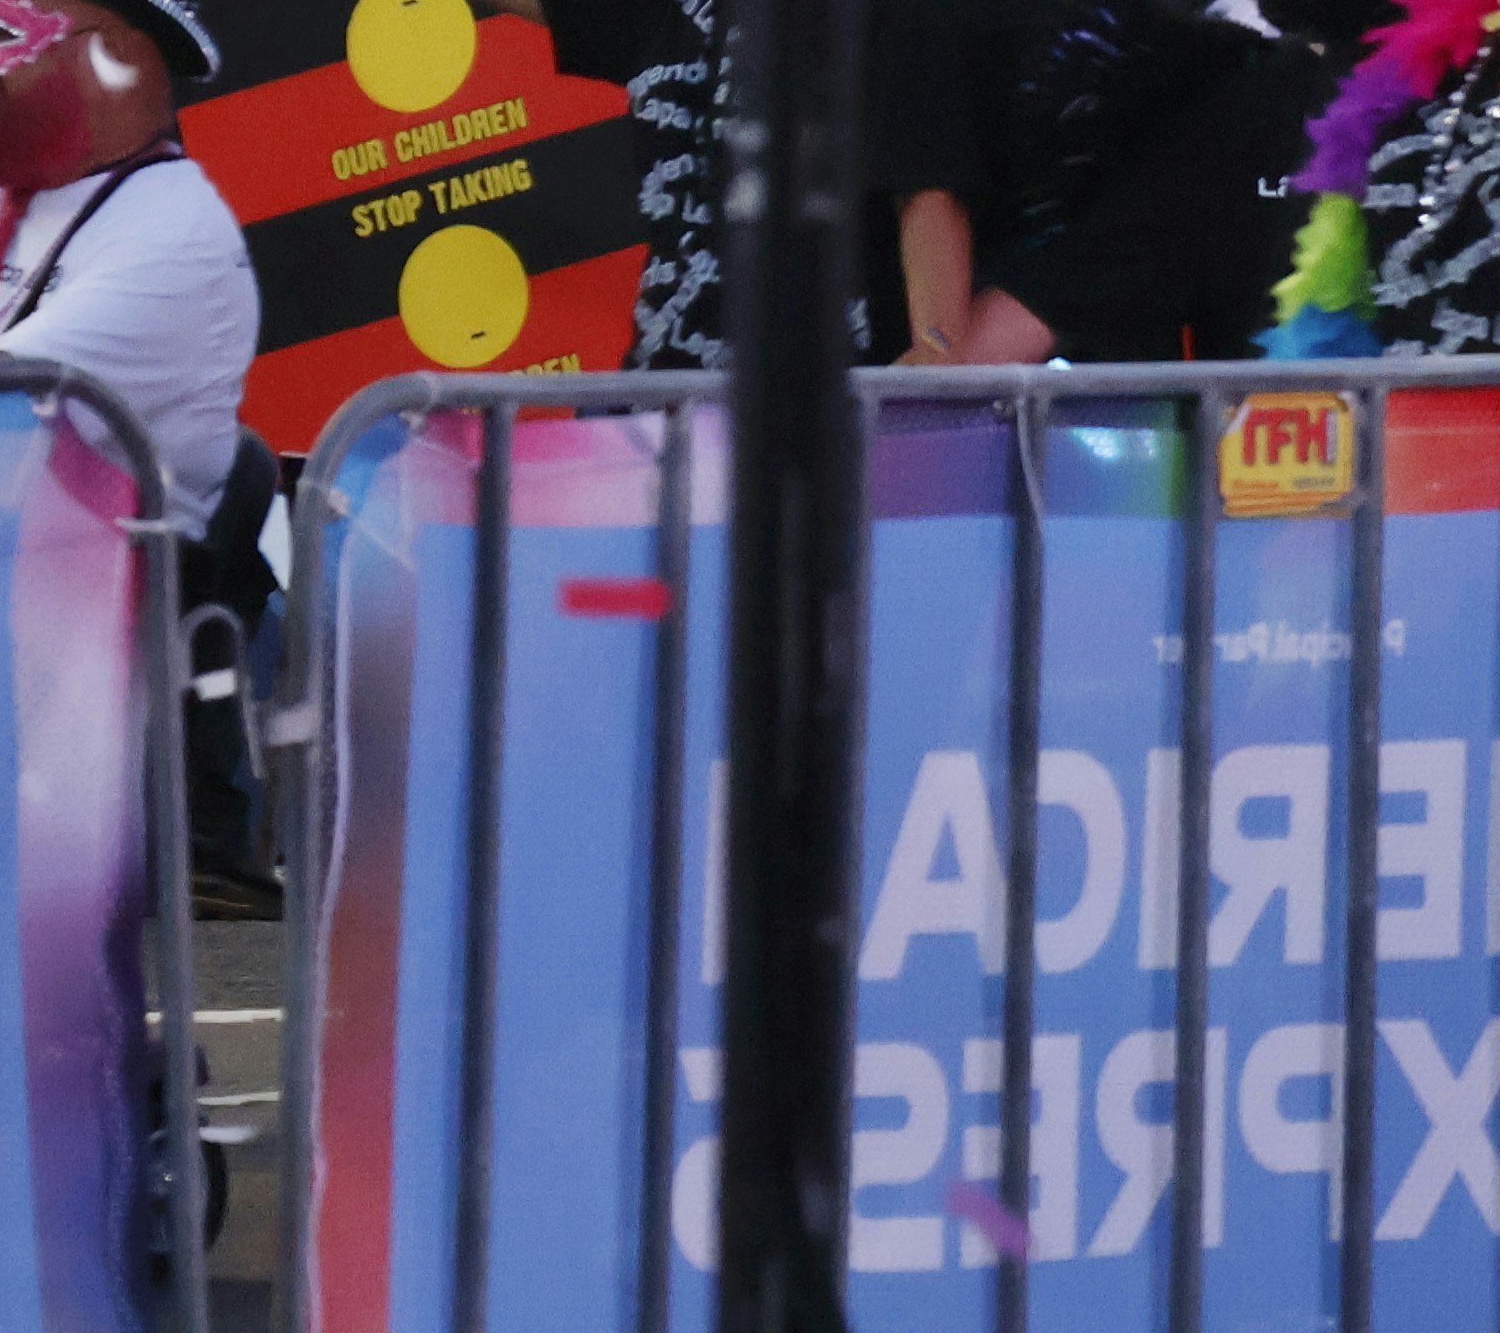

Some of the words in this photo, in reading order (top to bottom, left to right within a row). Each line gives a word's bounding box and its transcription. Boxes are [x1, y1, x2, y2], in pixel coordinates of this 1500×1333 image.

[331, 137, 388, 180] OUR
[394, 96, 528, 163] CHILDREN
[351, 190, 422, 237] STOP
[428, 159, 533, 214] TAKING
